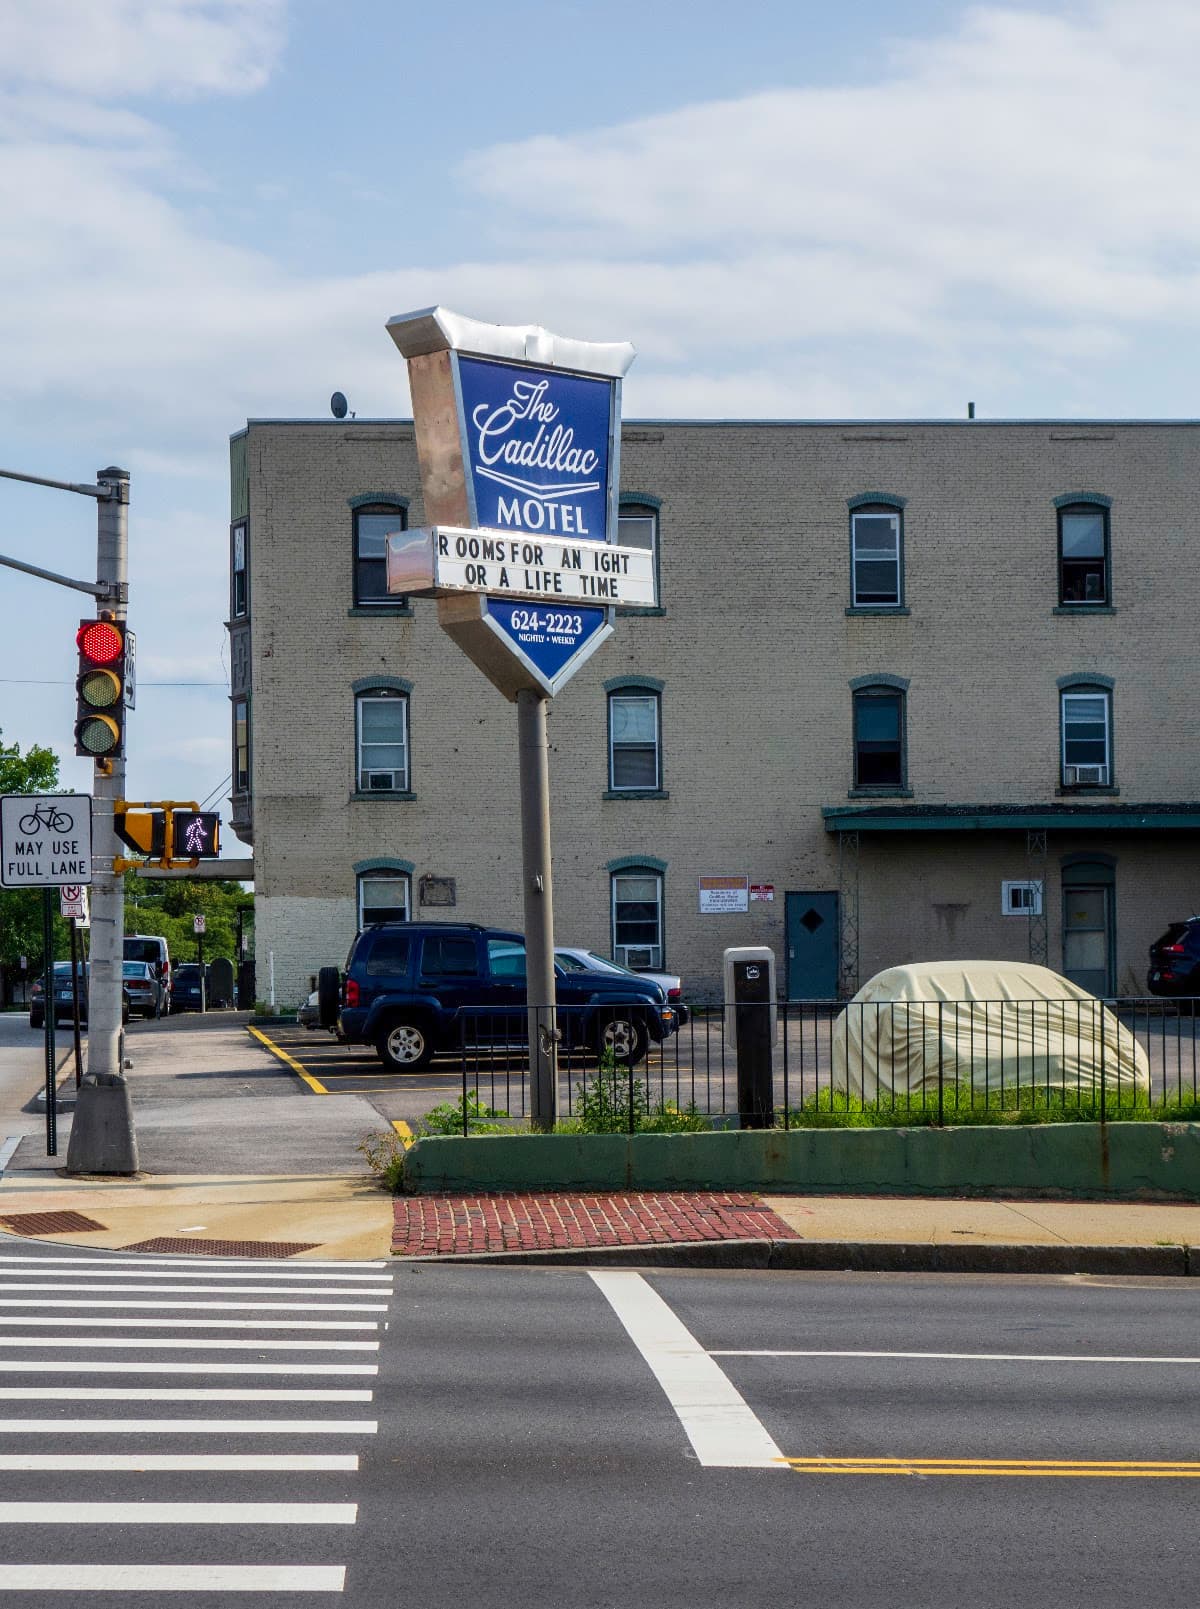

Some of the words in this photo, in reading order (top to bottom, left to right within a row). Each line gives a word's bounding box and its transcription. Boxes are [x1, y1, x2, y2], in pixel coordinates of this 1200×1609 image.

[507, 380, 559, 422] The
[473, 404, 598, 474] Cadillac
[497, 496, 588, 534] MOTEL
[511, 543, 543, 565] FOR
[562, 548, 581, 569] AN
[594, 552, 630, 574] IGHT
[465, 564, 487, 585] OR
[500, 567, 509, 587] A
[525, 570, 562, 592] LIFE
[580, 575, 618, 597] TIME
[511, 610, 582, 634] 624-2223
[519, 633, 545, 643] NIGHTLY
[552, 636, 576, 645] WEEKLY
[15, 842, 43, 855] MAY
[52, 841, 79, 855] USE
[8, 862, 43, 876] FULL
[51, 860, 86, 875] LANE
